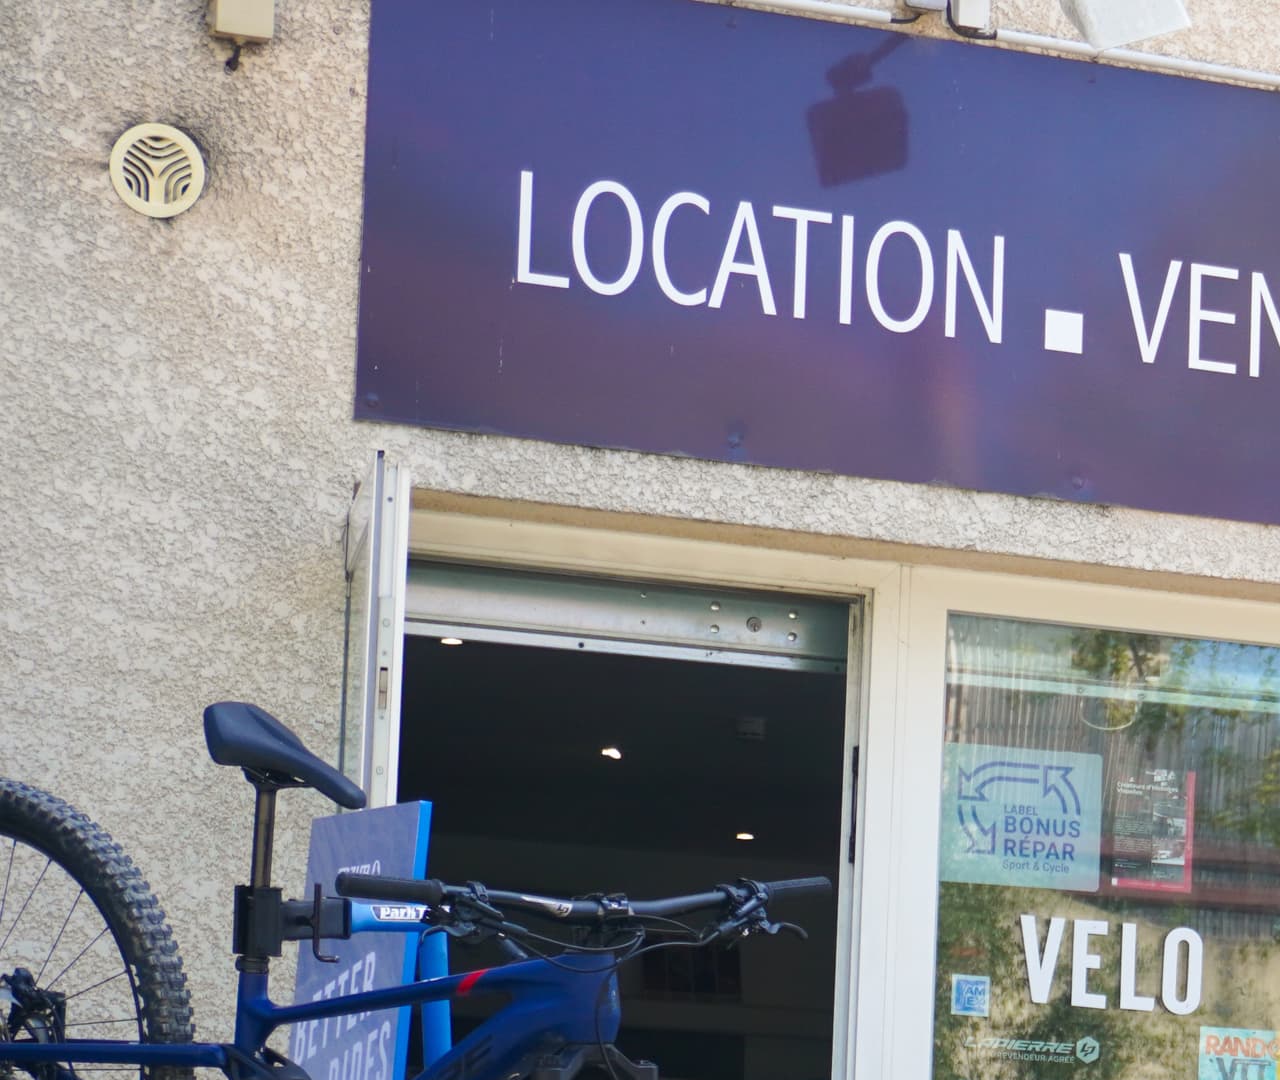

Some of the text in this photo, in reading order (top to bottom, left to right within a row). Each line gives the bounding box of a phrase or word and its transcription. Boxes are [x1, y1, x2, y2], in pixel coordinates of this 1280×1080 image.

[516, 170, 1005, 344] LOCATION
[1003, 803, 1039, 816] LABEL
[1003, 815, 1081, 838] BONUS
[1003, 836, 1075, 861] RÉPAR
[1001, 859, 1030, 872] Sport
[1042, 861, 1070, 874] Cycle
[1019, 914, 1204, 1015] VELO
[296, 951, 376, 1063] BETTER
[964, 1036, 1075, 1054] LAPIERRE
